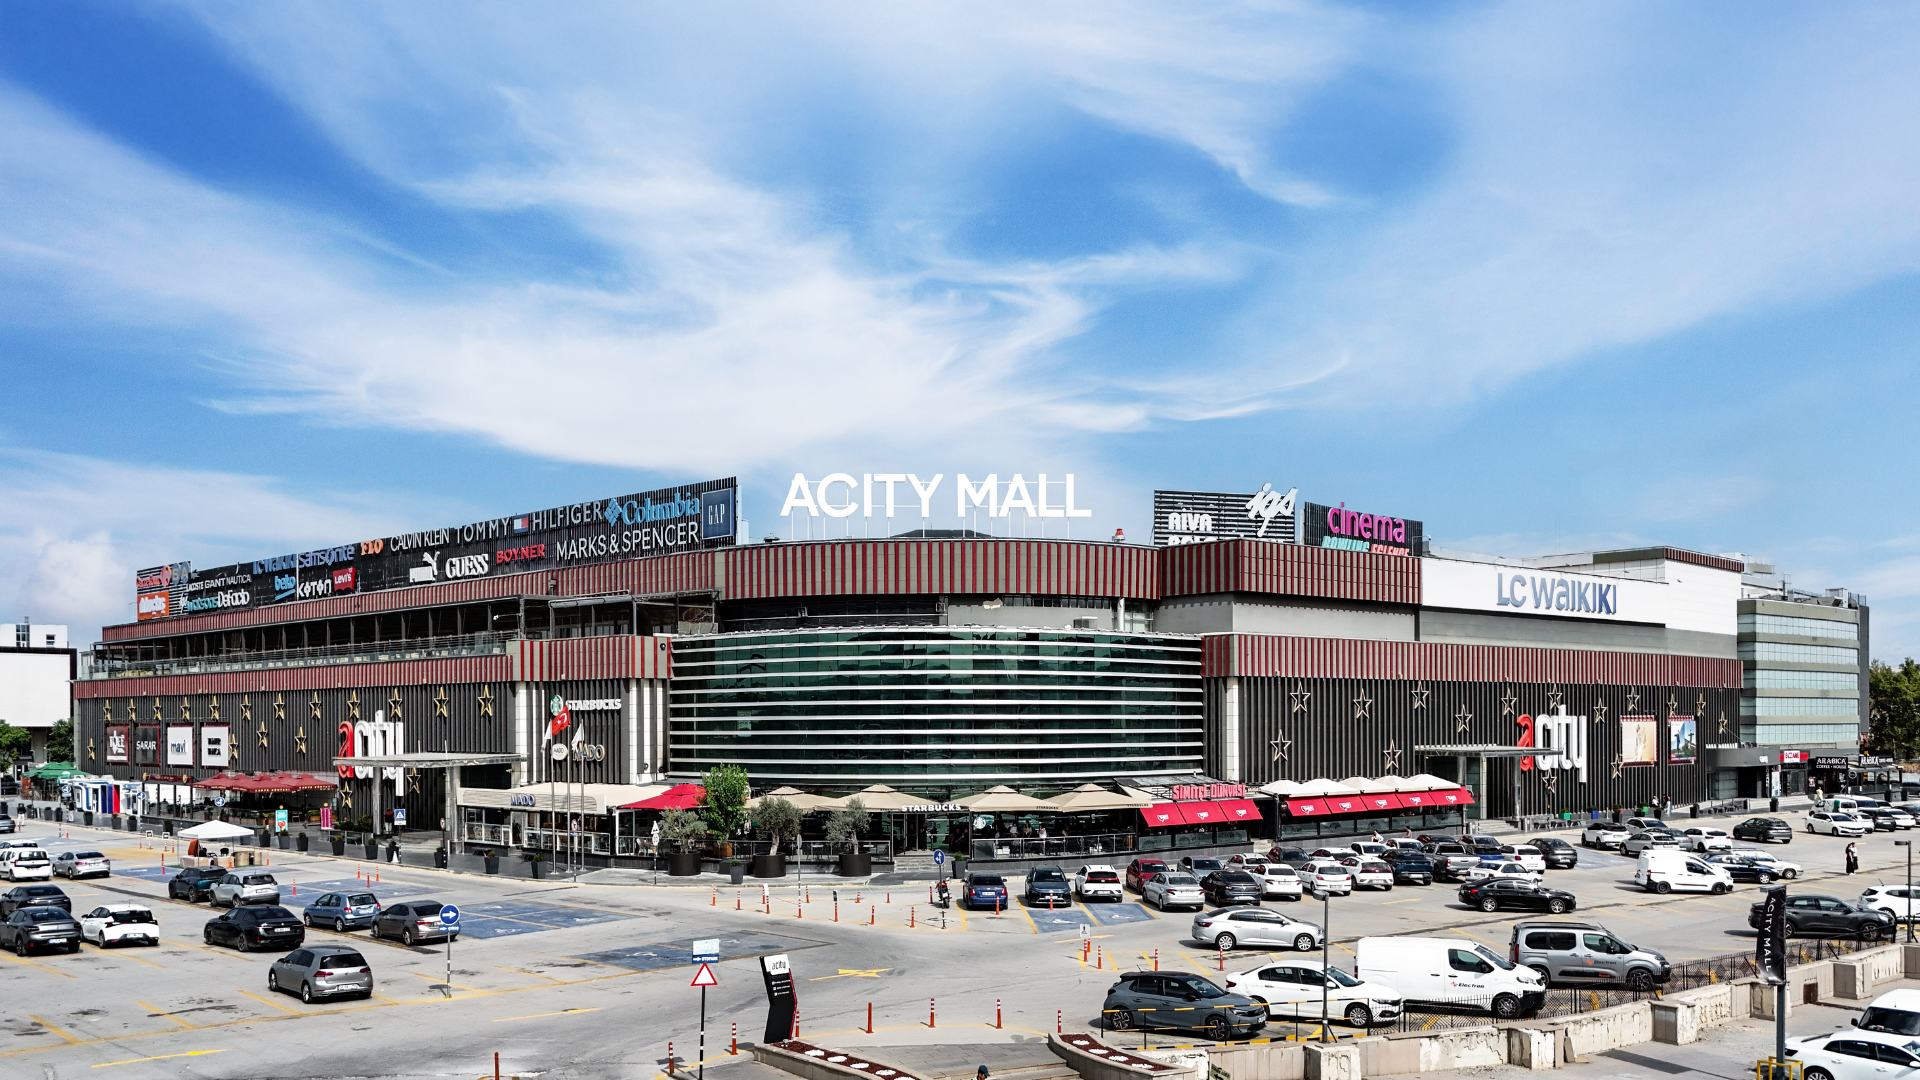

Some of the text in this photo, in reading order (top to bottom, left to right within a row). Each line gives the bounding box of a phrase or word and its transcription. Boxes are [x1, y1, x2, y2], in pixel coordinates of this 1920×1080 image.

[780, 473, 1092, 518] ACITY MALL
[621, 492, 700, 526] Columbia
[708, 503, 725, 525] GAP
[457, 501, 603, 544] TOMMY HILFIGER
[1328, 502, 1406, 543] cinema
[361, 539, 384, 556] FLO
[390, 528, 450, 552] CALVIN KLEIN
[556, 522, 699, 561] MARKS & SPENCER
[496, 544, 546, 564] BOYNER
[445, 553, 489, 579] GUESS
[205, 578, 226, 589] GANT
[226, 574, 252, 586] NAUTICA
[274, 574, 296, 591] beko
[217, 589, 250, 607] DeFacto
[1497, 573, 1527, 608] LC
[565, 699, 622, 711] STARBUCKS
[136, 740, 157, 751] SARAR
[170, 739, 187, 753] mavi
[511, 793, 536, 807] MADO
[901, 803, 962, 812] STARBUCKS
[1763, 897, 1776, 972] ACITY MALL
[771, 961, 787, 970] acity
